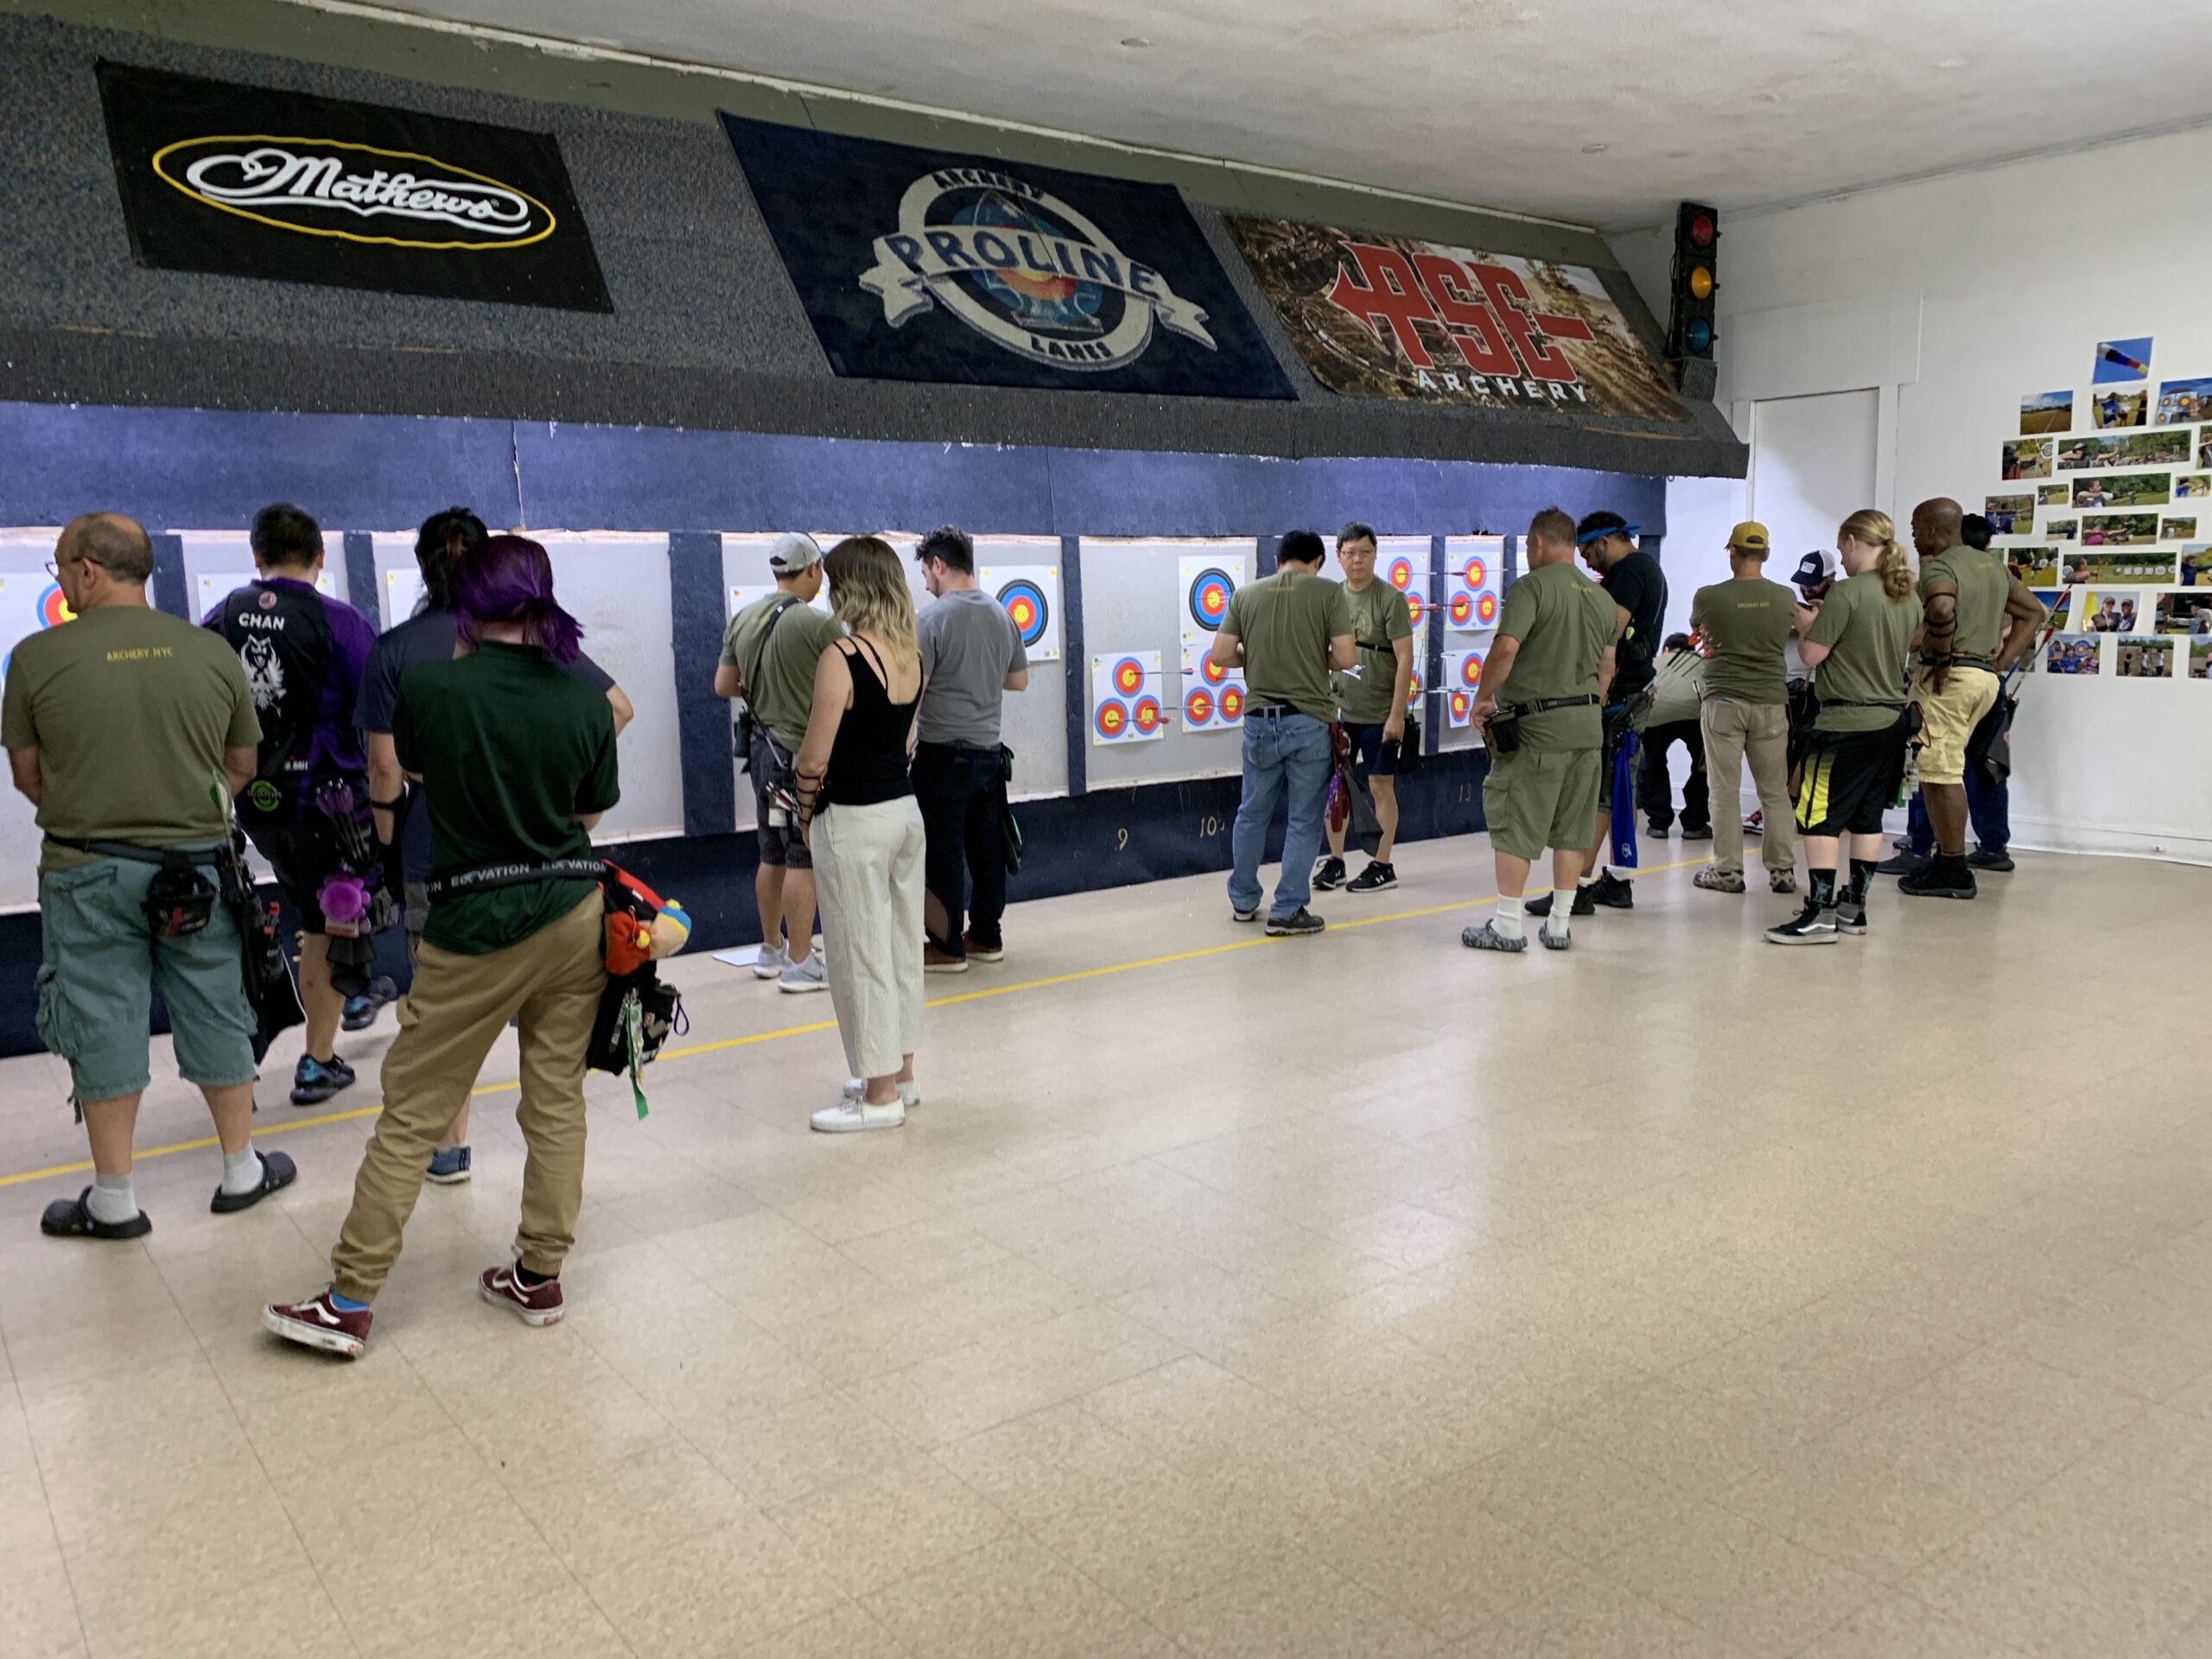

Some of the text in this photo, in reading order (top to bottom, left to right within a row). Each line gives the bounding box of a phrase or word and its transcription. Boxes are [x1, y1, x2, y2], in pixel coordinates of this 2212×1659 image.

[187, 148, 530, 233] Mathews
[883, 227, 1162, 301] PROLINE
[1325, 240, 1595, 383] PSE
[1030, 334, 1113, 360] LANES
[1417, 368, 1587, 403] ARCHERY
[238, 612, 285, 632] CHAN
[1117, 828, 1128, 850] 9
[1199, 815, 1217, 838] 10
